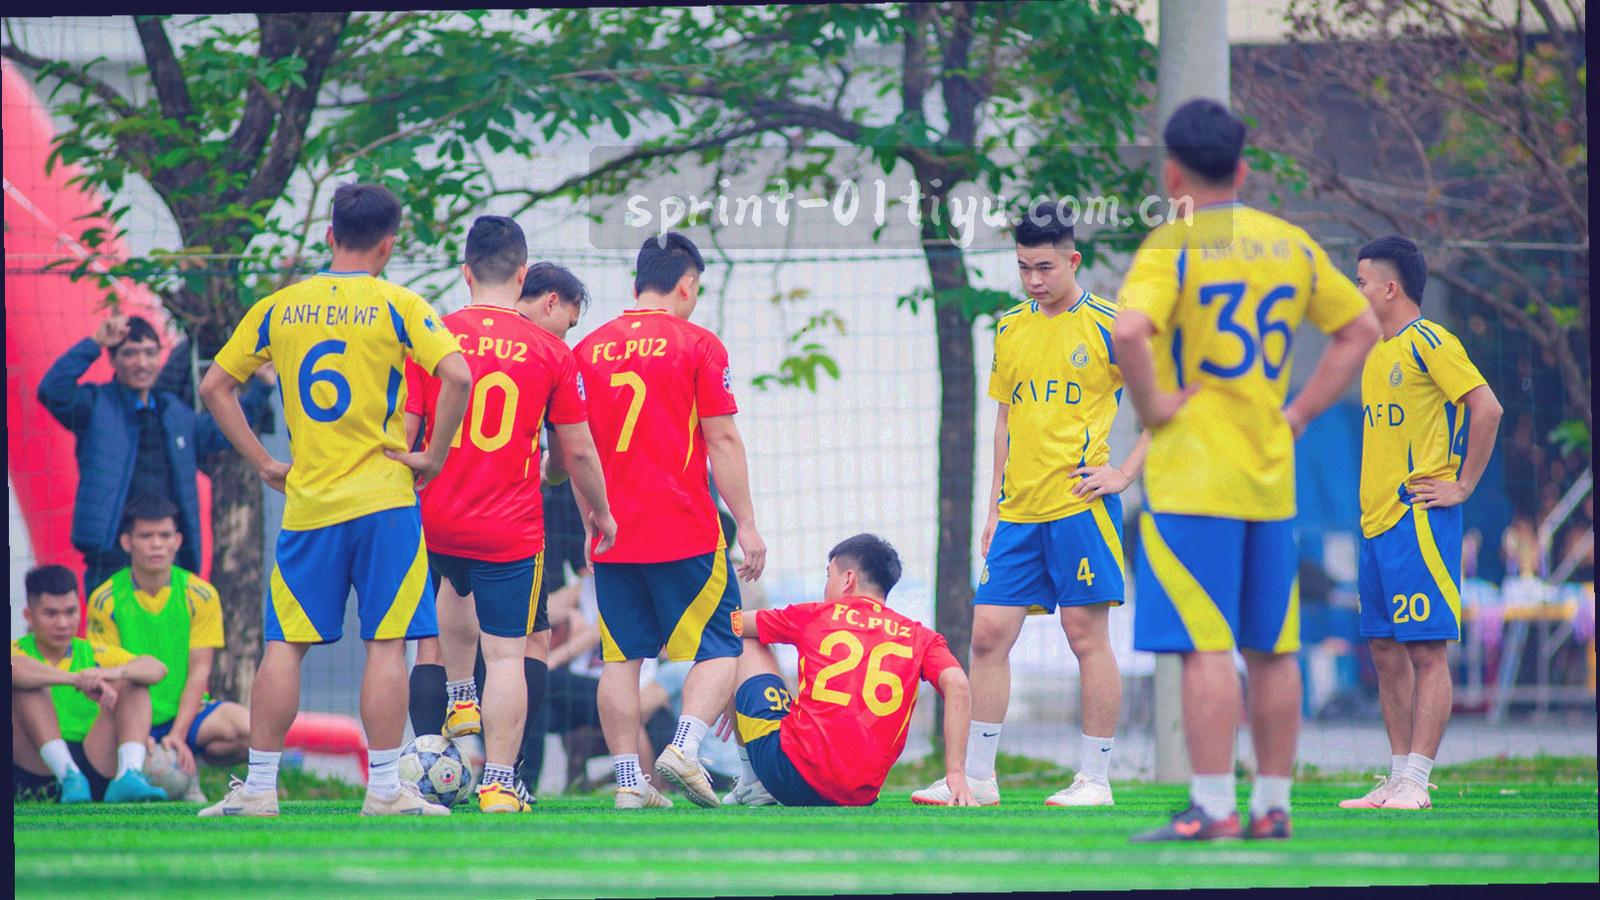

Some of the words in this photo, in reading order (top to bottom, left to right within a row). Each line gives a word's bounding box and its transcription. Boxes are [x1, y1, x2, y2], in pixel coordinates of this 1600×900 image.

[281, 304, 321, 326] ANH
[326, 305, 348, 326] EM
[353, 305, 379, 326] WF
[1199, 282, 1297, 381] 36
[455, 333, 528, 363] C.PU2
[592, 338, 667, 364] FC.PU2
[298, 339, 352, 423] 6
[450, 371, 519, 452] 0
[610, 371, 647, 452] 7
[1077, 557, 1095, 586] 4
[1392, 592, 1431, 624] 20
[811, 630, 914, 717] 26
